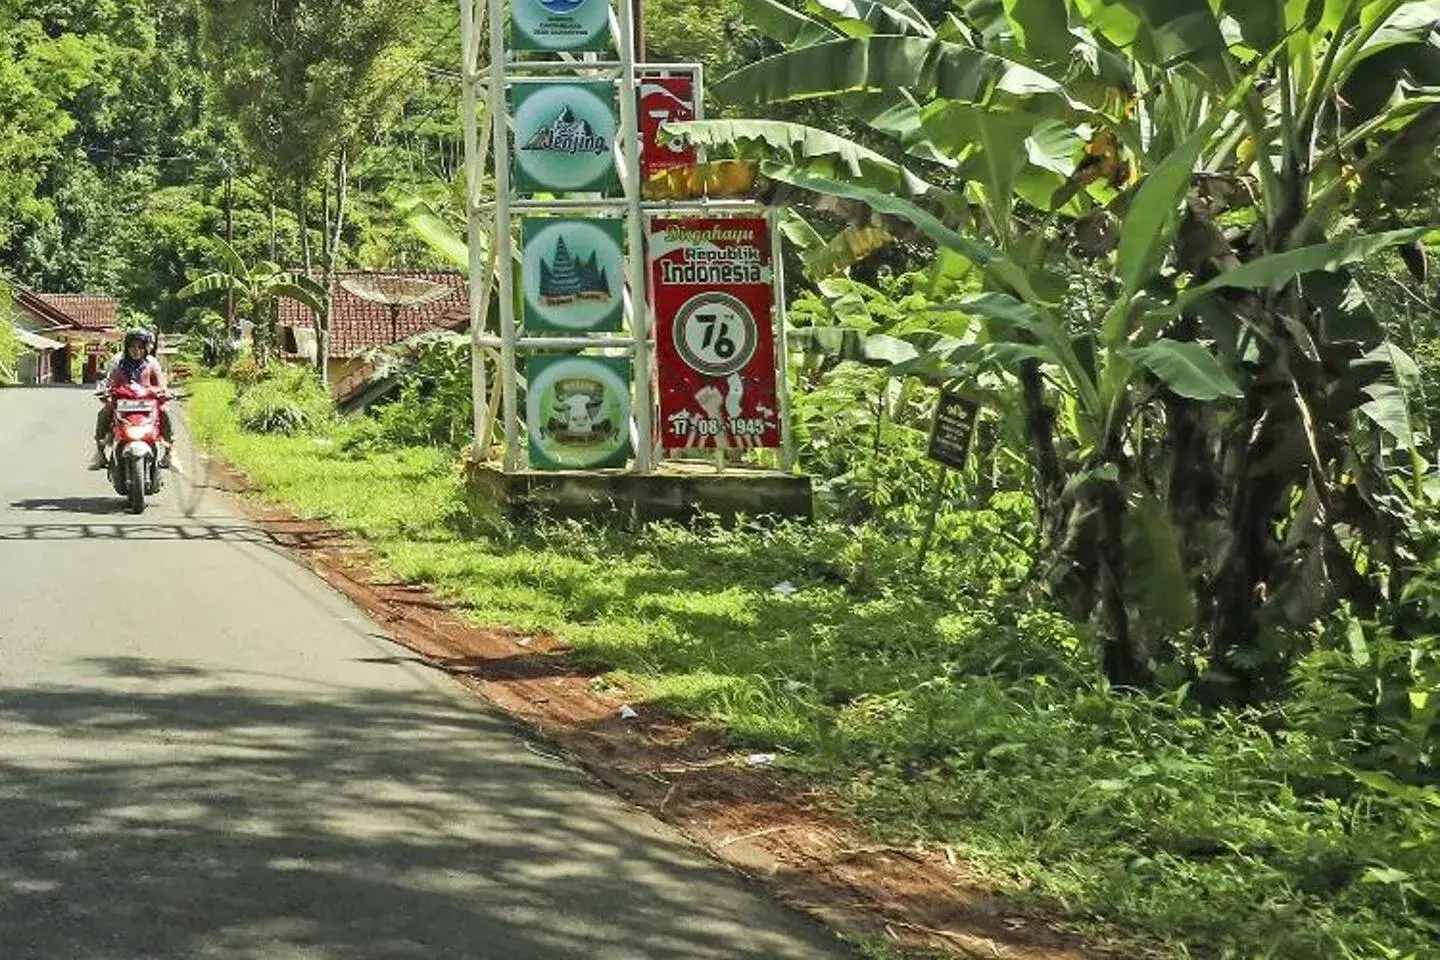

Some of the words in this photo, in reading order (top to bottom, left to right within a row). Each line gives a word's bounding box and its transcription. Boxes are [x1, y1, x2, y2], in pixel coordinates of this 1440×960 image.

[683, 246, 760, 261] Republik
[662, 260, 761, 284] Indonesia
[694, 314, 736, 359] 76
